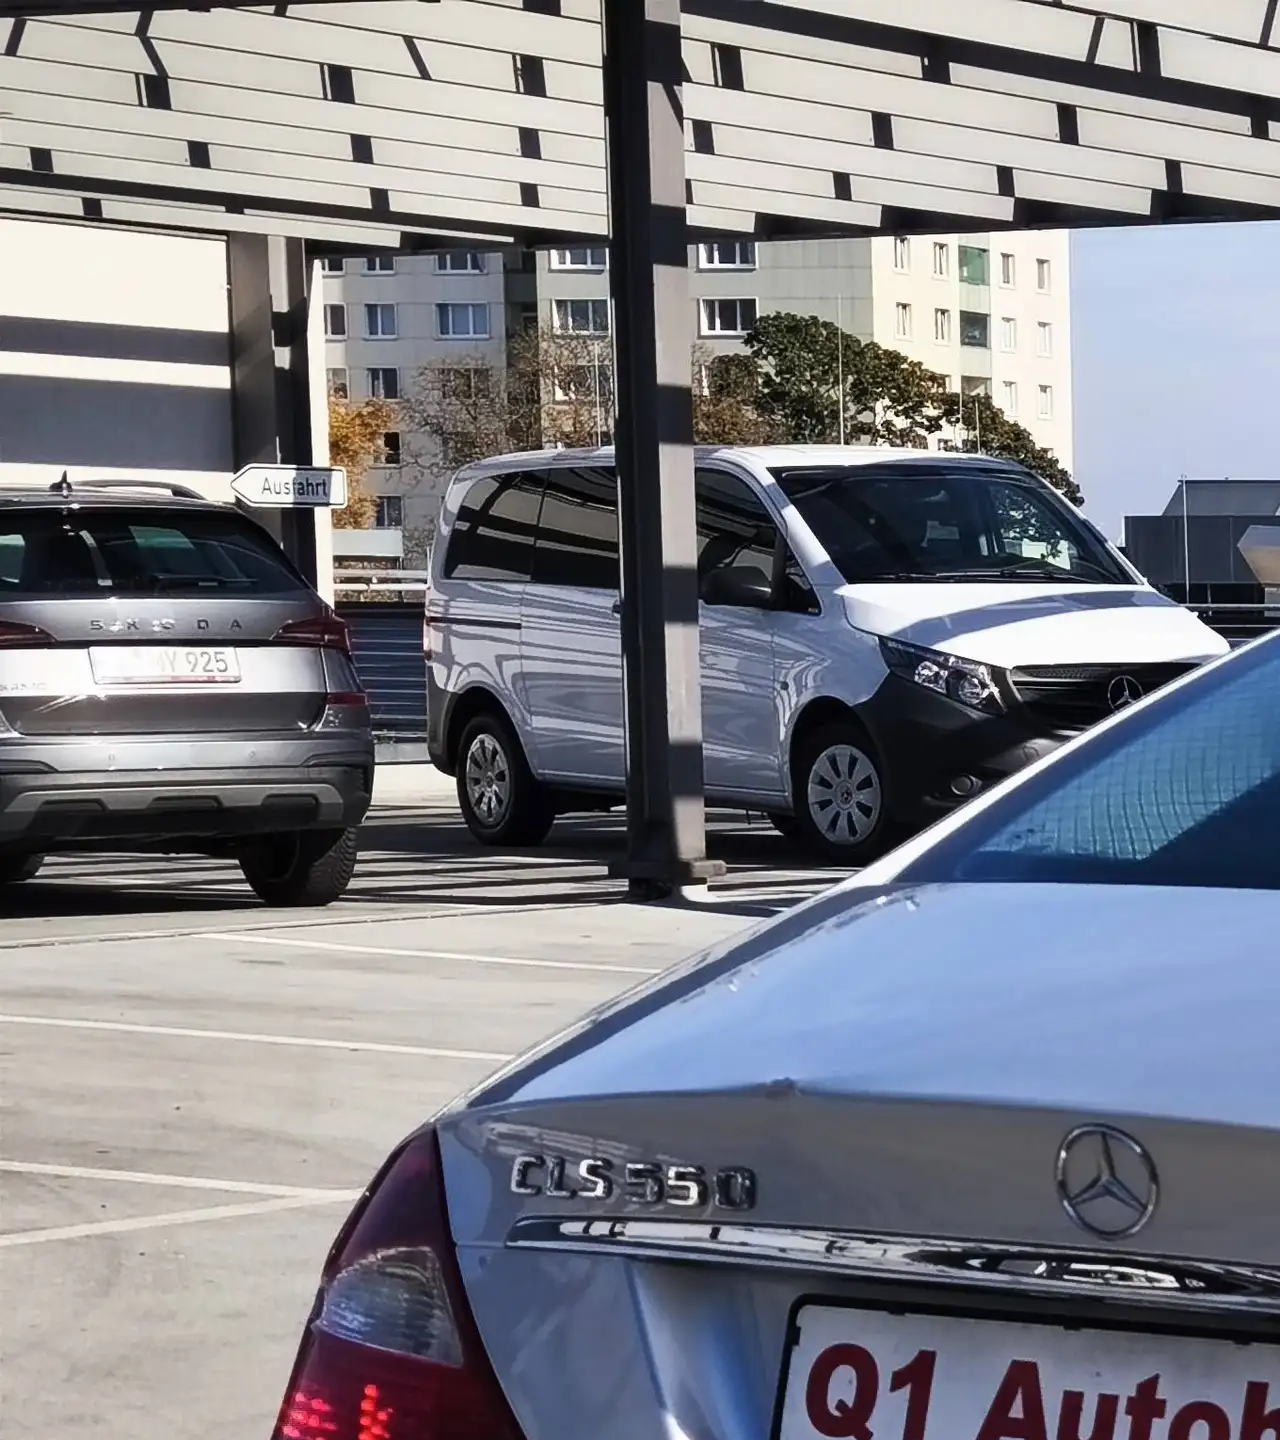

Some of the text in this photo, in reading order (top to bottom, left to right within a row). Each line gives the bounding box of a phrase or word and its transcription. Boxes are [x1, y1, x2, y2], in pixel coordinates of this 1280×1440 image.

[262, 477, 328, 497] Ausfahrt
[183, 650, 229, 674] 925
[510, 1154, 614, 1199] CLS
